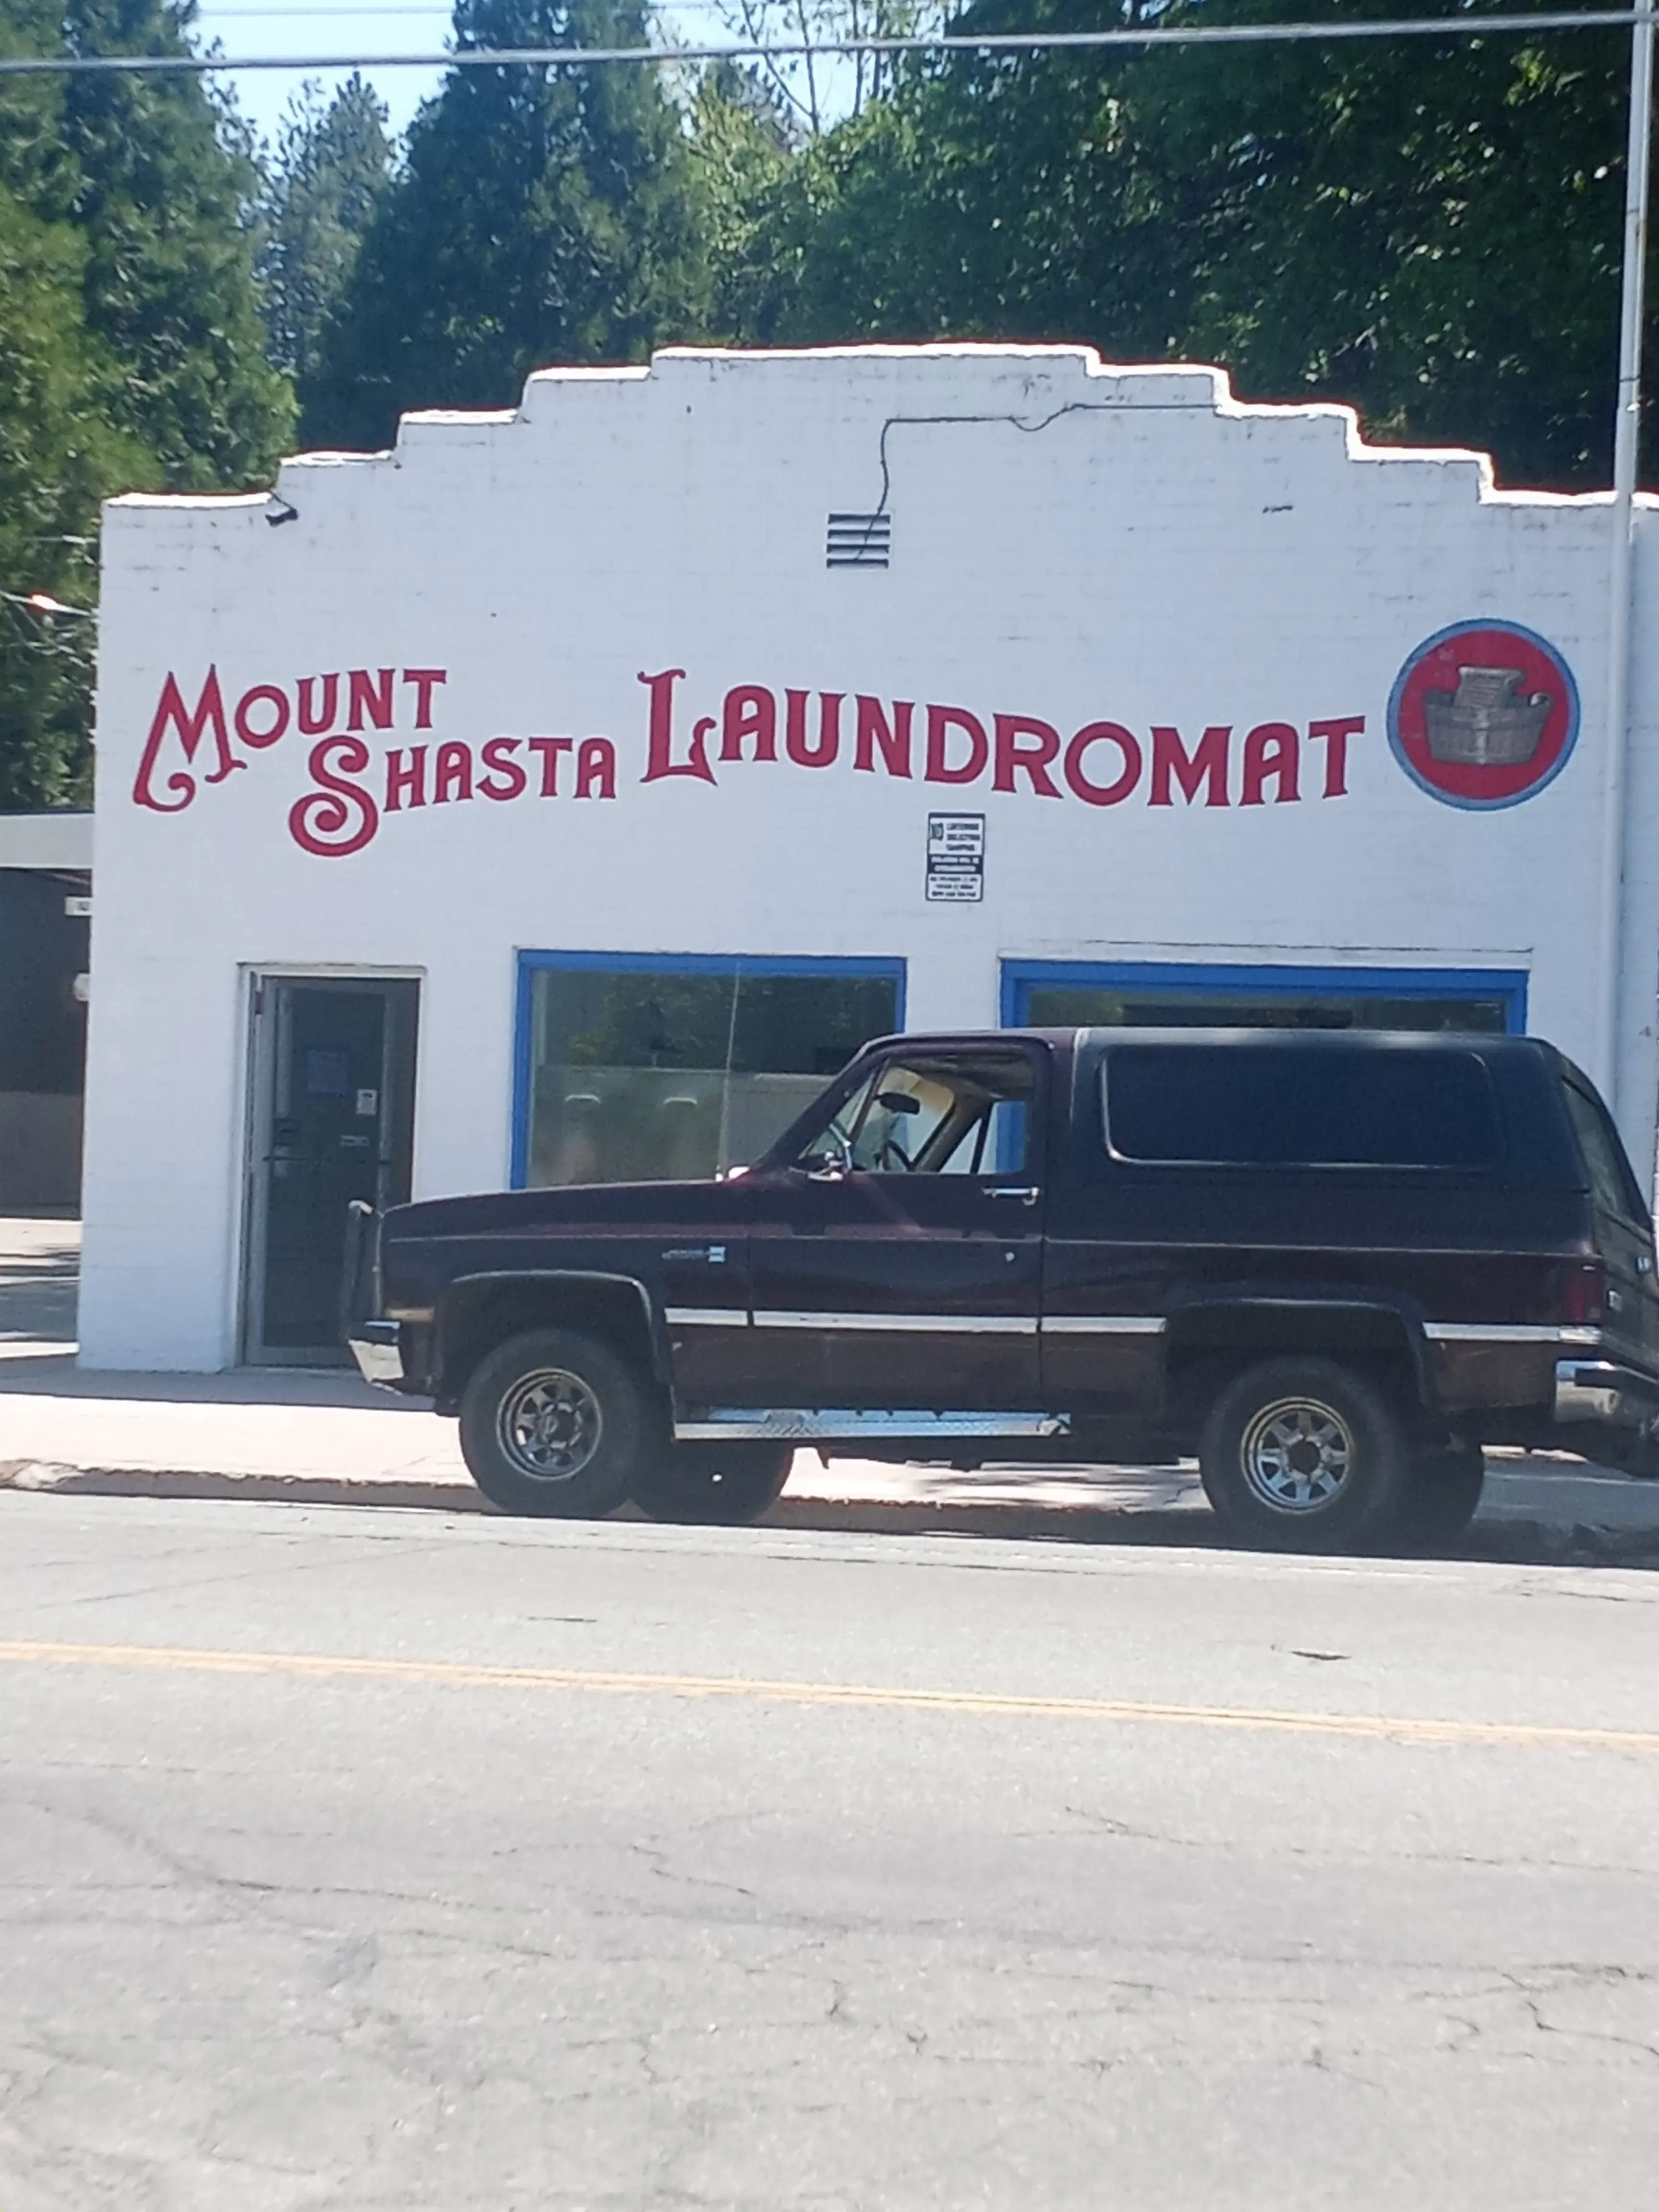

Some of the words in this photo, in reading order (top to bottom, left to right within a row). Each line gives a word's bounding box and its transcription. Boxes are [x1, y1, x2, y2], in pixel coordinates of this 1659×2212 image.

[133, 663, 447, 813] MOUNT
[289, 735, 616, 857] SHASTA
[640, 669, 1365, 806] LAUNDROMAT
